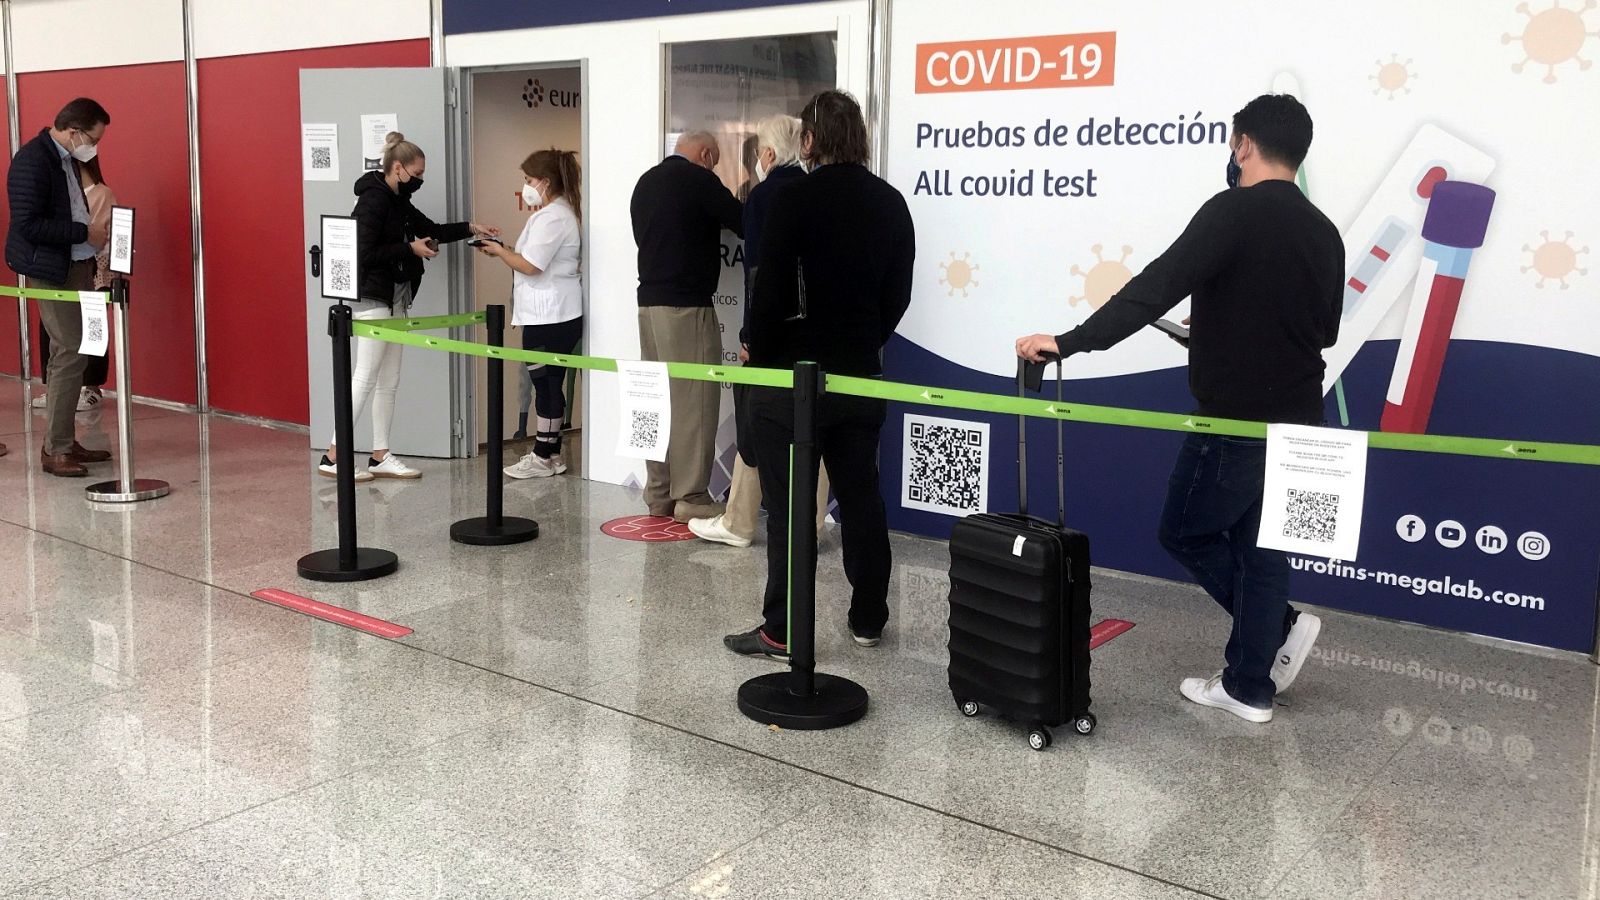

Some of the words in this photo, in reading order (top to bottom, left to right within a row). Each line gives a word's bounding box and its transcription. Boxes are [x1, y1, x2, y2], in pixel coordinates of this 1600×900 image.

[925, 43, 1103, 87] COVID-19
[549, 88, 581, 108] eur
[916, 120, 1025, 149] Pruebas
[1033, 118, 1068, 147] de
[1076, 110, 1227, 147] detección
[913, 168, 952, 197] All
[960, 168, 1034, 197] covid
[1043, 168, 1098, 198] test
[1286, 555, 1546, 611] urofins-megalab.com
